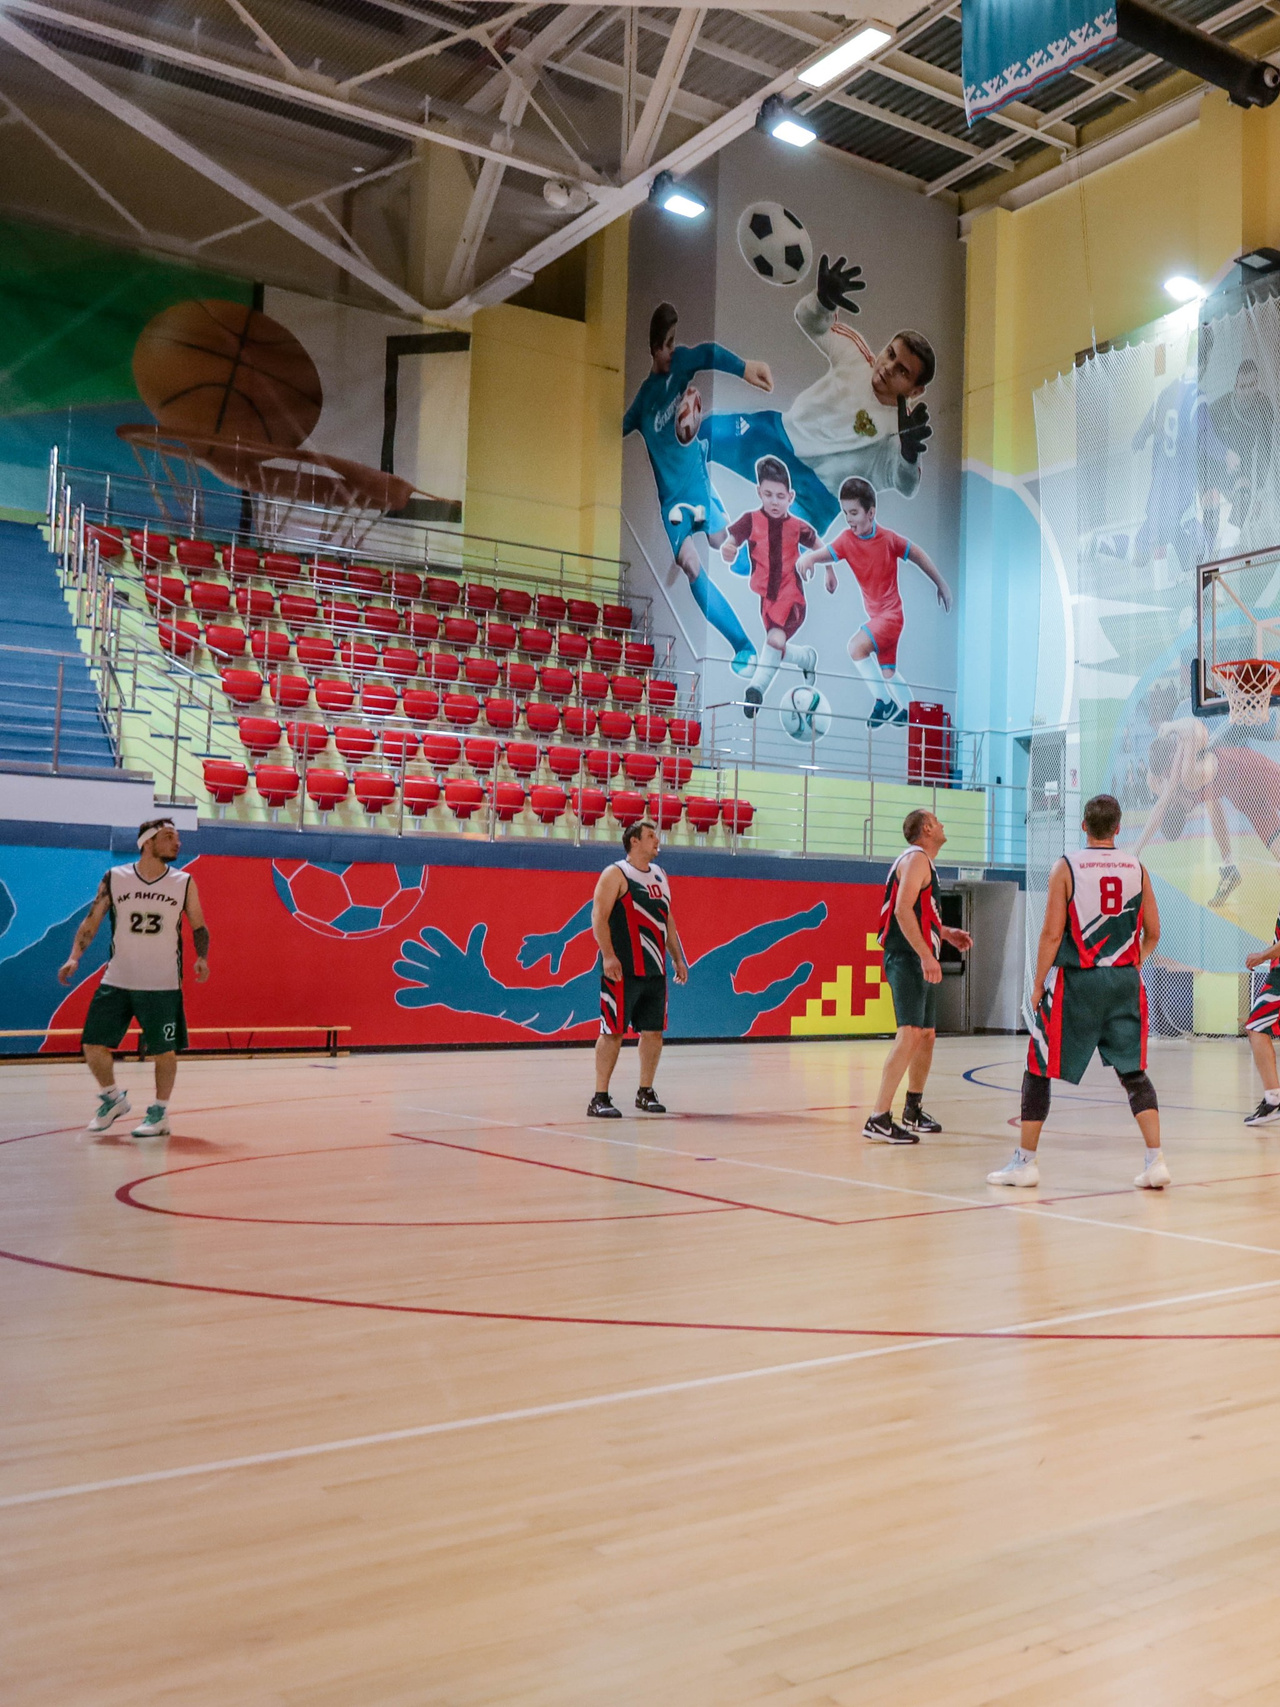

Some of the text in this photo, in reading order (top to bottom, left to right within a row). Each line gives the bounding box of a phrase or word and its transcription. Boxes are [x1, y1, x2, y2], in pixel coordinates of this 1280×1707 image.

[1164, 408, 1179, 458] 9
[134, 891, 178, 907] ЯНГПУР
[646, 884, 663, 898] 10
[1099, 876, 1123, 915] 8
[129, 912, 163, 935] 23
[163, 1022, 177, 1041] 2
